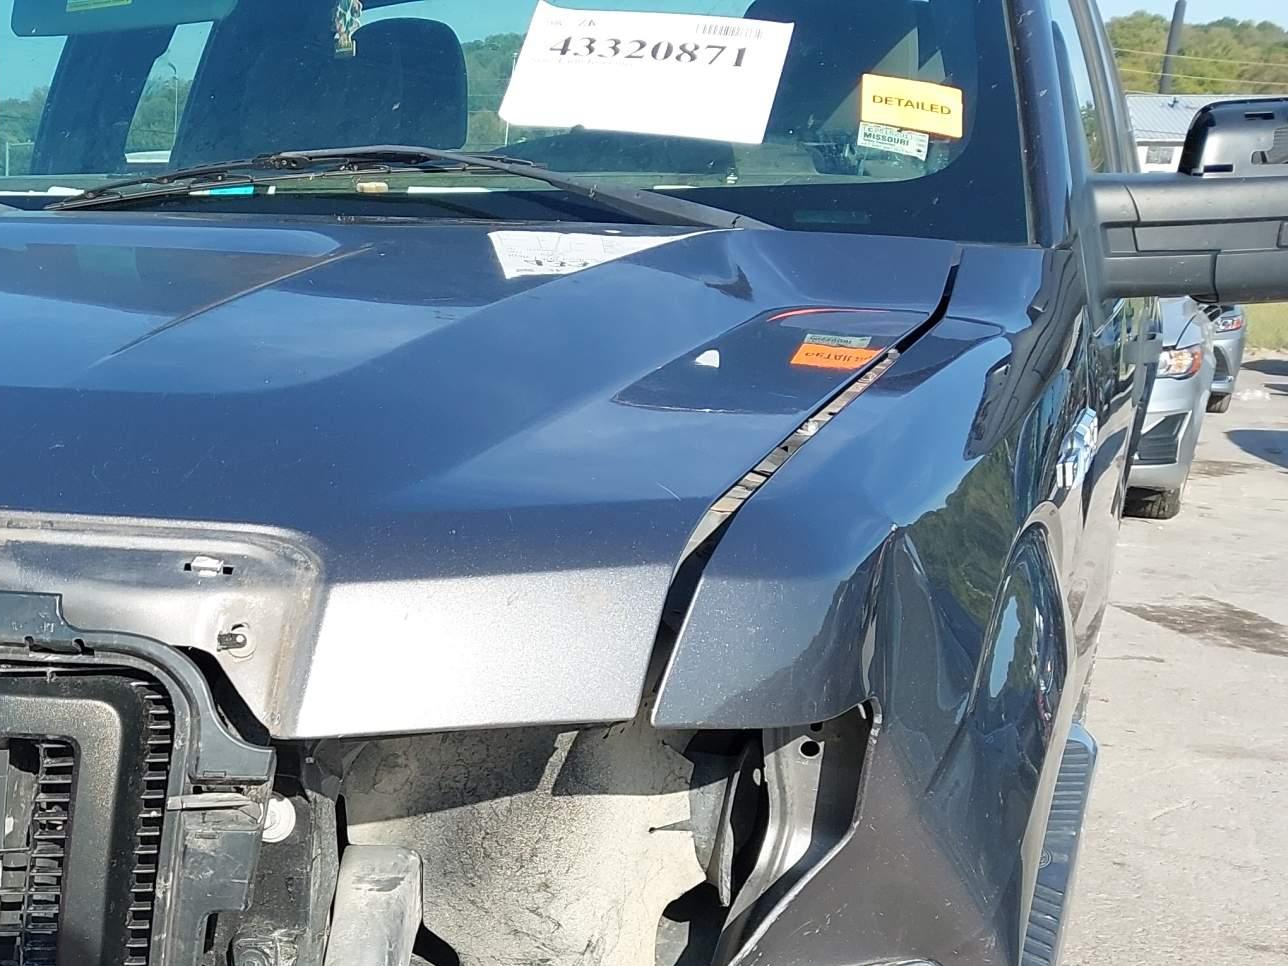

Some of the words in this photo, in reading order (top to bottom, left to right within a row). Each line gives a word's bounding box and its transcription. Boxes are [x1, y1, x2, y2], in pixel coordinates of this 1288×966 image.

[549, 35, 747, 67] 43320871
[872, 94, 952, 115] DETAILED
[863, 131, 910, 146] MISSOURI
